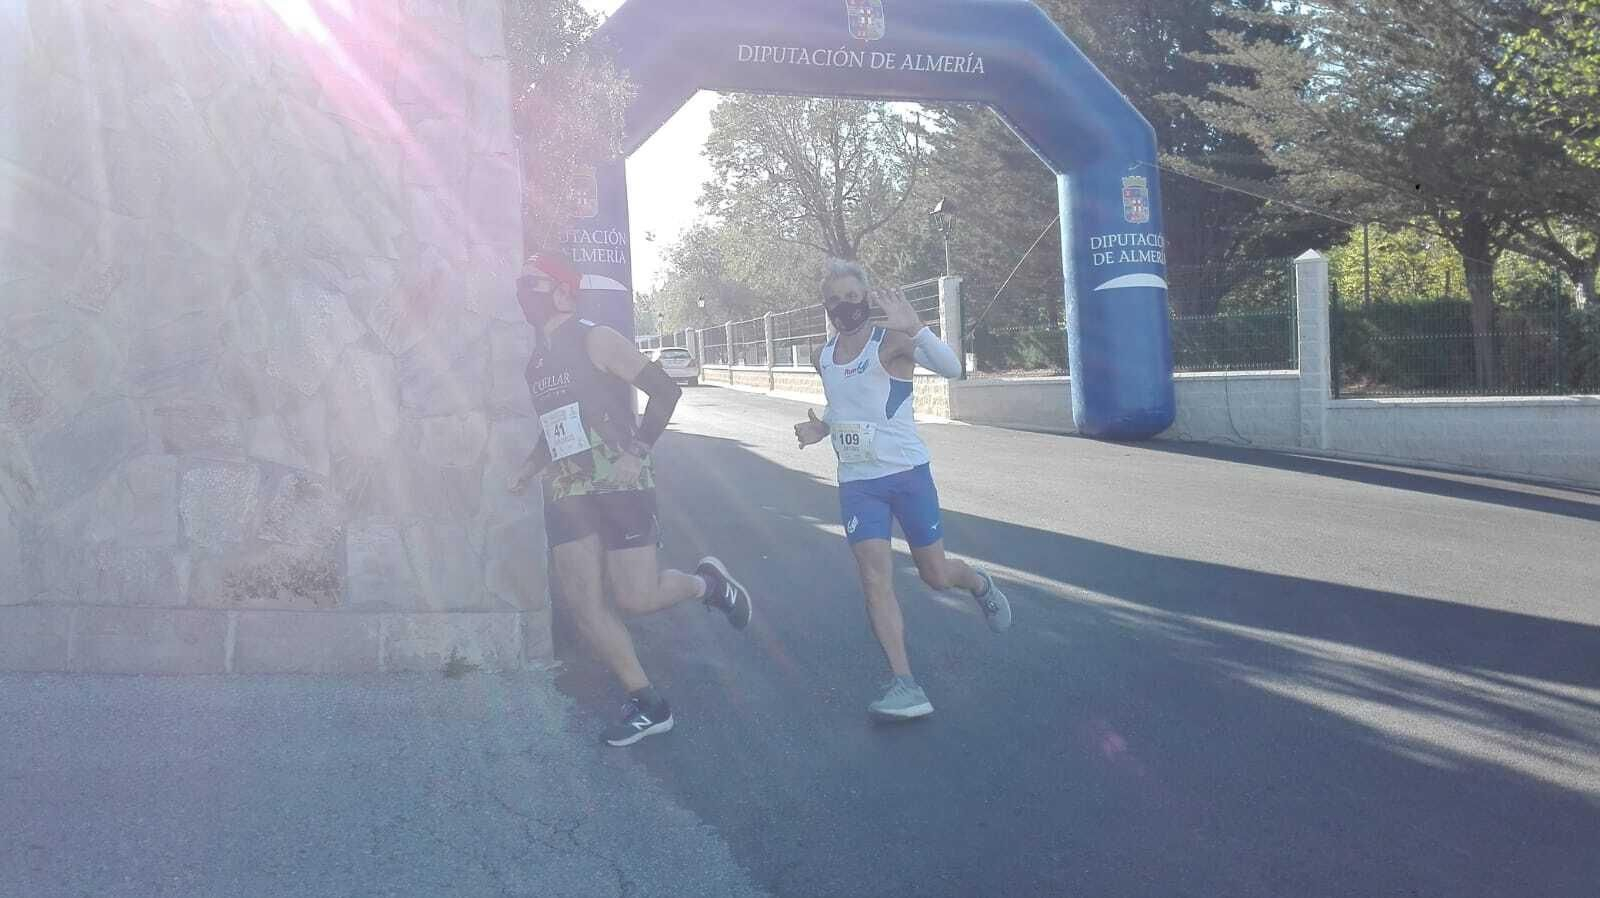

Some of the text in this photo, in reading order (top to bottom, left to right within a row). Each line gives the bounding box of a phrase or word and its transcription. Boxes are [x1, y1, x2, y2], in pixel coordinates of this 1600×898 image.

[737, 44, 985, 74] DIPUTACIÓN DE ALMERÍA
[1090, 232, 1165, 250] DIPUTACIÓ
[1093, 249, 1167, 266] DE ALMERÍ
[554, 422, 566, 436] 41
[839, 433, 860, 446] 109
